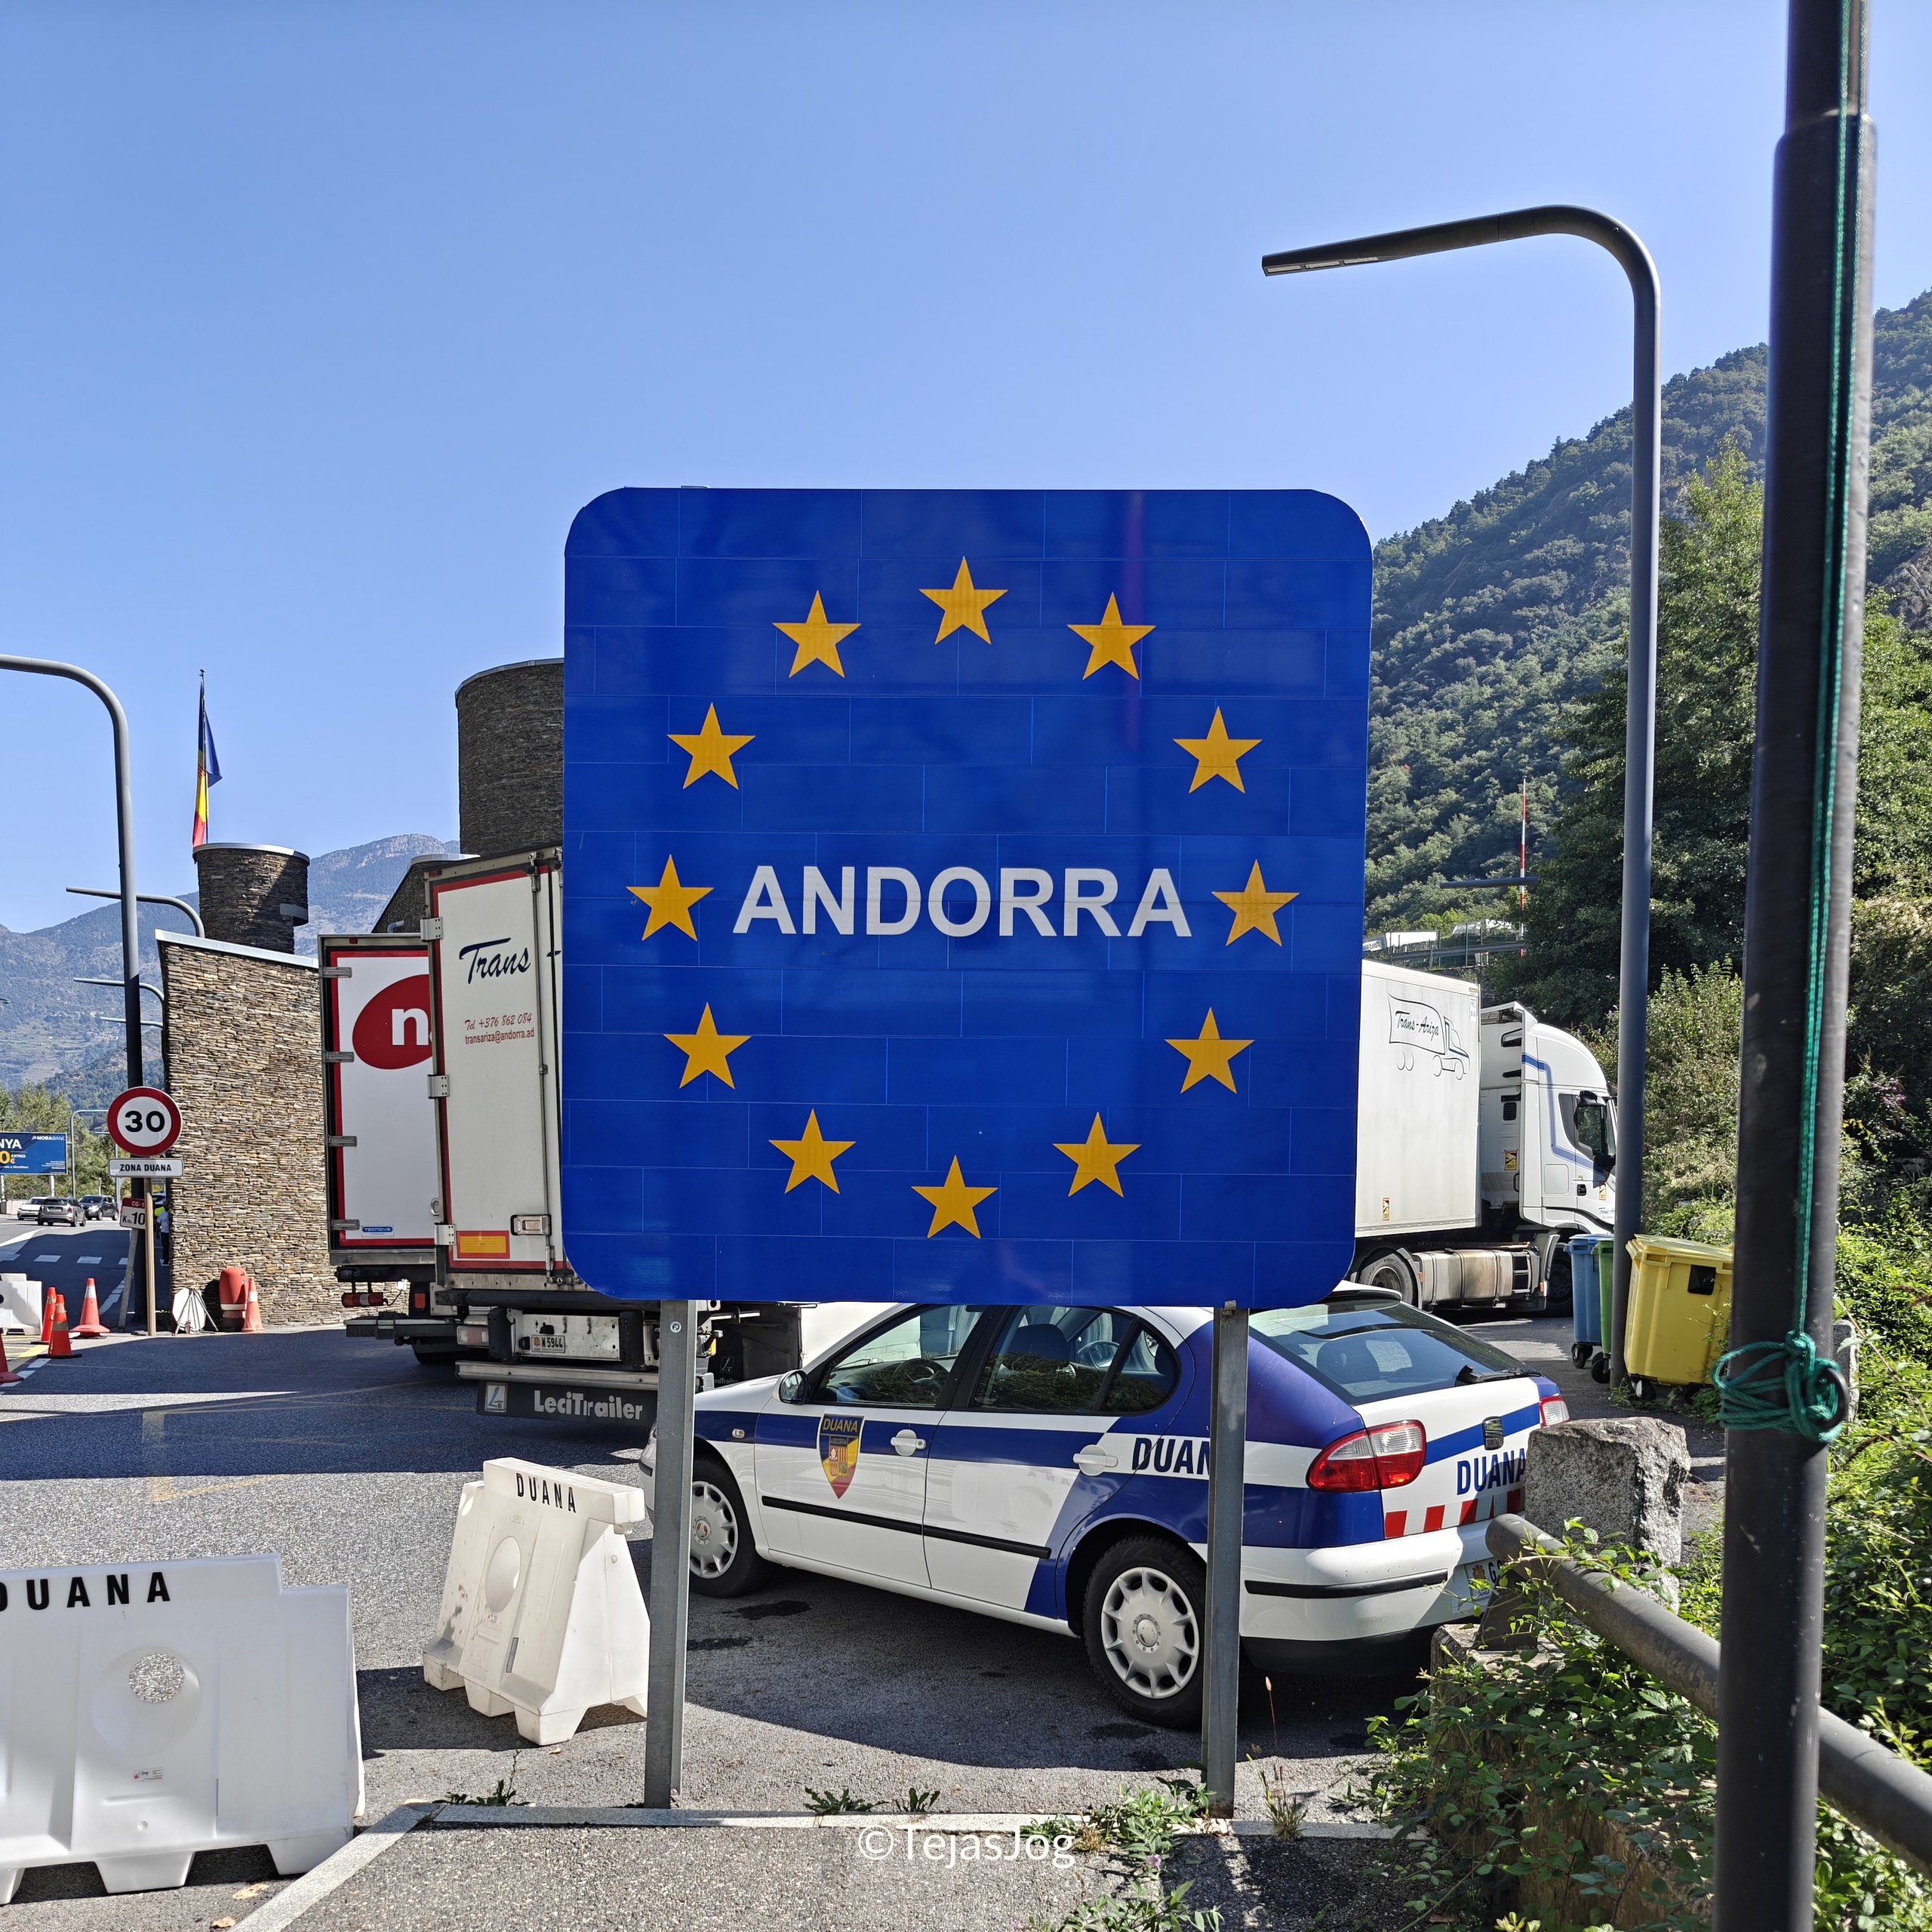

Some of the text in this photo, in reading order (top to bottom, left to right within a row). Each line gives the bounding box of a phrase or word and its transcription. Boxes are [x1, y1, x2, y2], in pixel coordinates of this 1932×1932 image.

[733, 865, 1192, 937] ANDORRA
[392, 1008, 432, 1046] n
[465, 1012, 532, 1031] Tel +376 862 084
[465, 1026, 535, 1044] transariza@andorra.ad
[125, 1110, 165, 1133] 30
[119, 1164, 172, 1172] ZONA DUANA
[534, 1390, 643, 1420] LeciTrailer
[823, 1418, 858, 1433] DUANA
[1132, 1437, 1209, 1475] DUAN
[516, 1472, 577, 1513] DUANA
